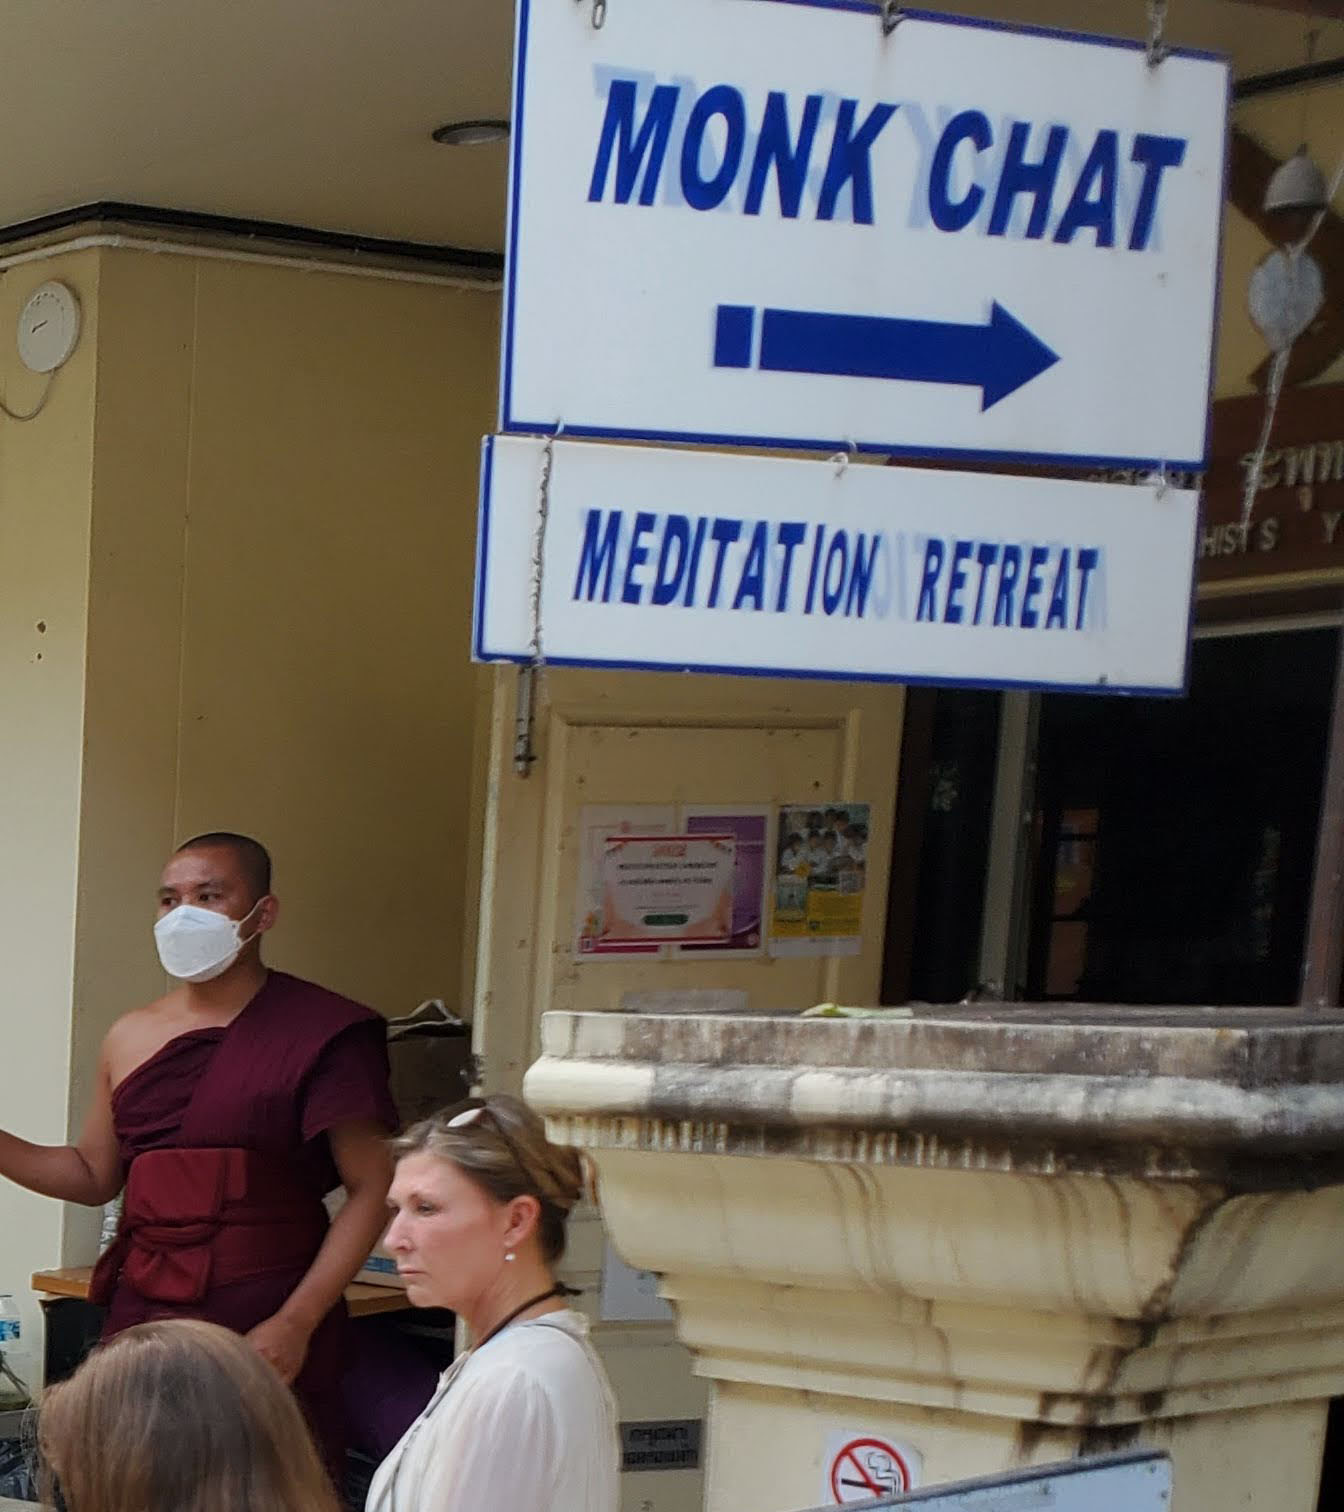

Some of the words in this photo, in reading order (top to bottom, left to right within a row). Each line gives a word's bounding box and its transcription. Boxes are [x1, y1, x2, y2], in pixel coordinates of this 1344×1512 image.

[587, 78, 899, 226] MONK
[928, 108, 1186, 252] CHAT
[572, 508, 880, 620] MEDITATION
[914, 544, 1099, 633] RETREAT
